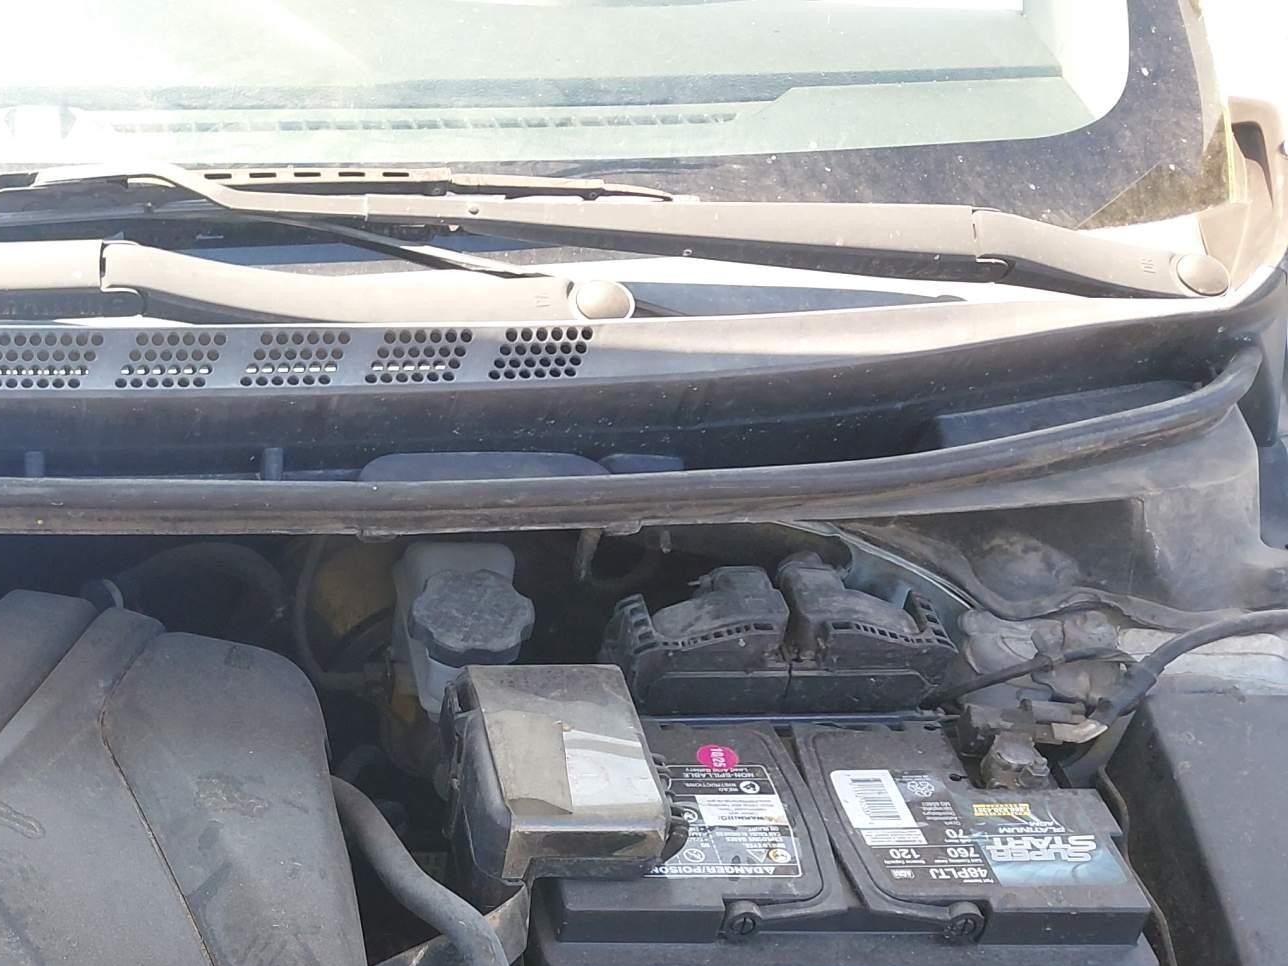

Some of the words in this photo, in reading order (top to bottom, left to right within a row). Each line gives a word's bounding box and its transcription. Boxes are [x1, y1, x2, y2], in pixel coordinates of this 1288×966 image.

[945, 828, 968, 839] 70
[986, 834, 1097, 850] START
[889, 847, 921, 859] 120
[946, 846, 980, 858] 760
[989, 848, 1092, 862] SUPER
[928, 867, 988, 880] 48PLTJ
